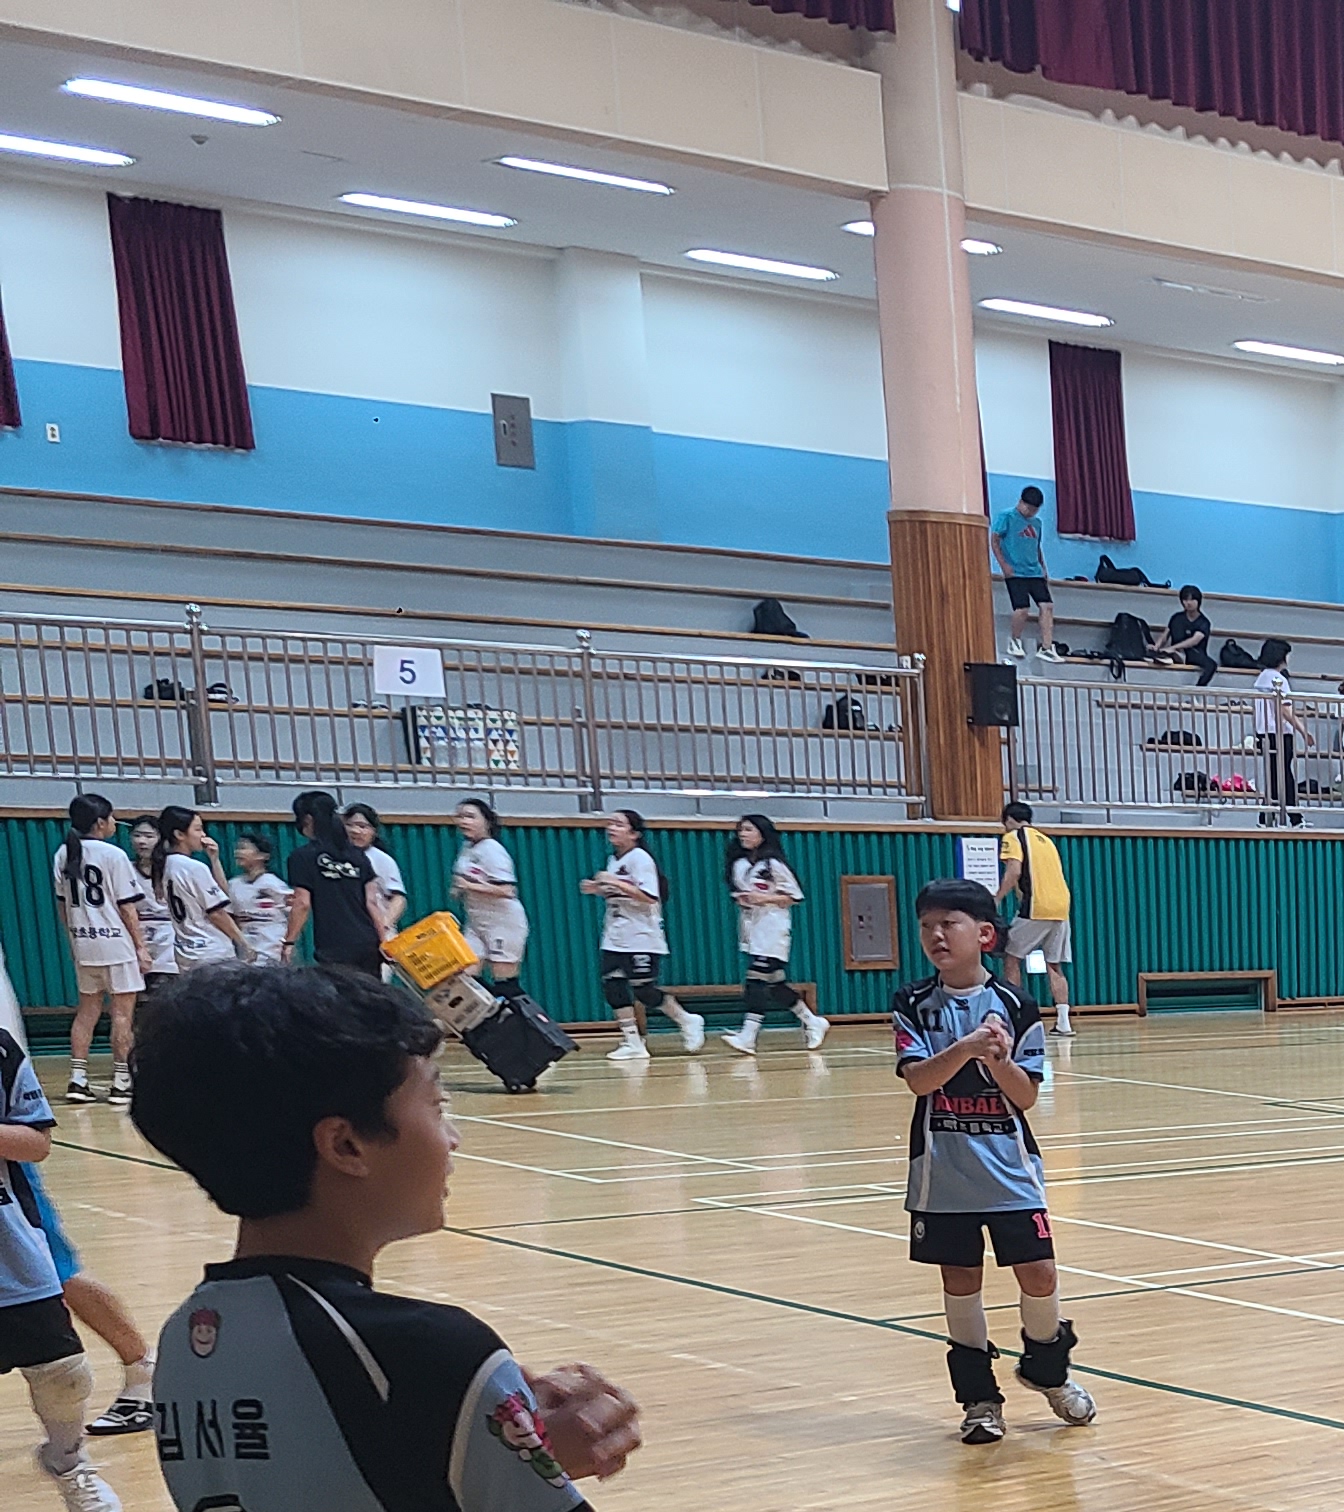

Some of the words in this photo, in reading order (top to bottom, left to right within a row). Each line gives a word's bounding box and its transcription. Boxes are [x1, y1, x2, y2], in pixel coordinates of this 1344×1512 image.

[399, 659, 416, 684] 5
[69, 863, 105, 909] 18
[919, 1008, 944, 1032] 11
